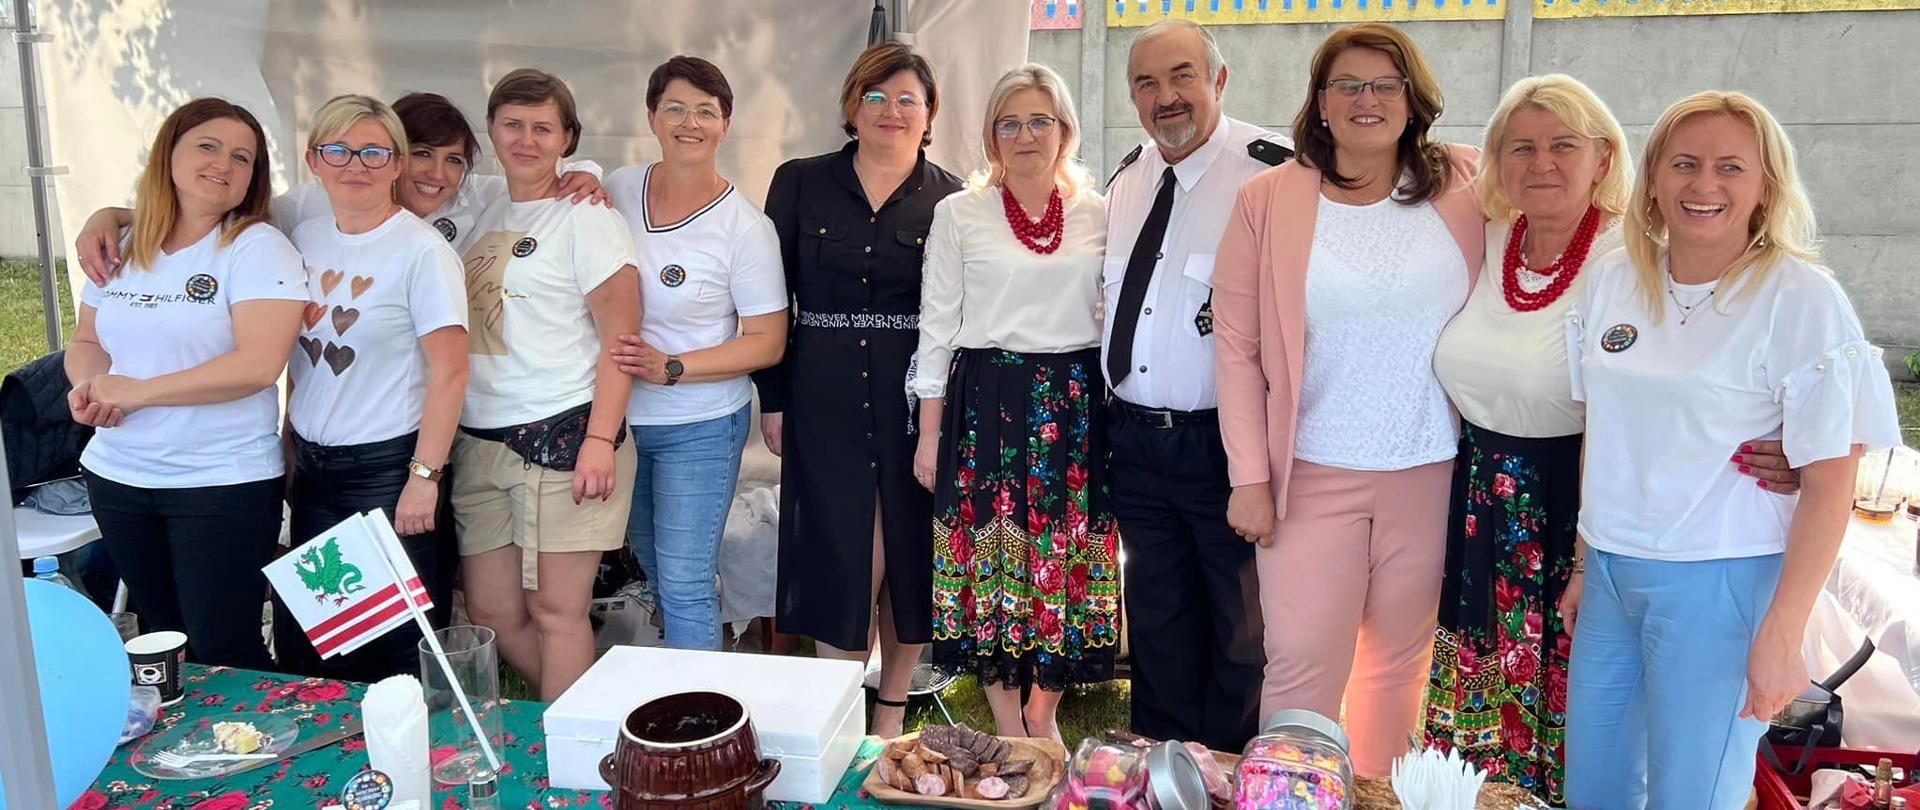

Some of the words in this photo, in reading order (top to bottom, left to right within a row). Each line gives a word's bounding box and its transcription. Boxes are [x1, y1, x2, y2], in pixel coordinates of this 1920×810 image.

[815, 312, 848, 321] NEVER
[851, 313, 885, 321] MIND
[821, 319, 850, 328] MIND
[853, 320, 890, 329] NEVER
